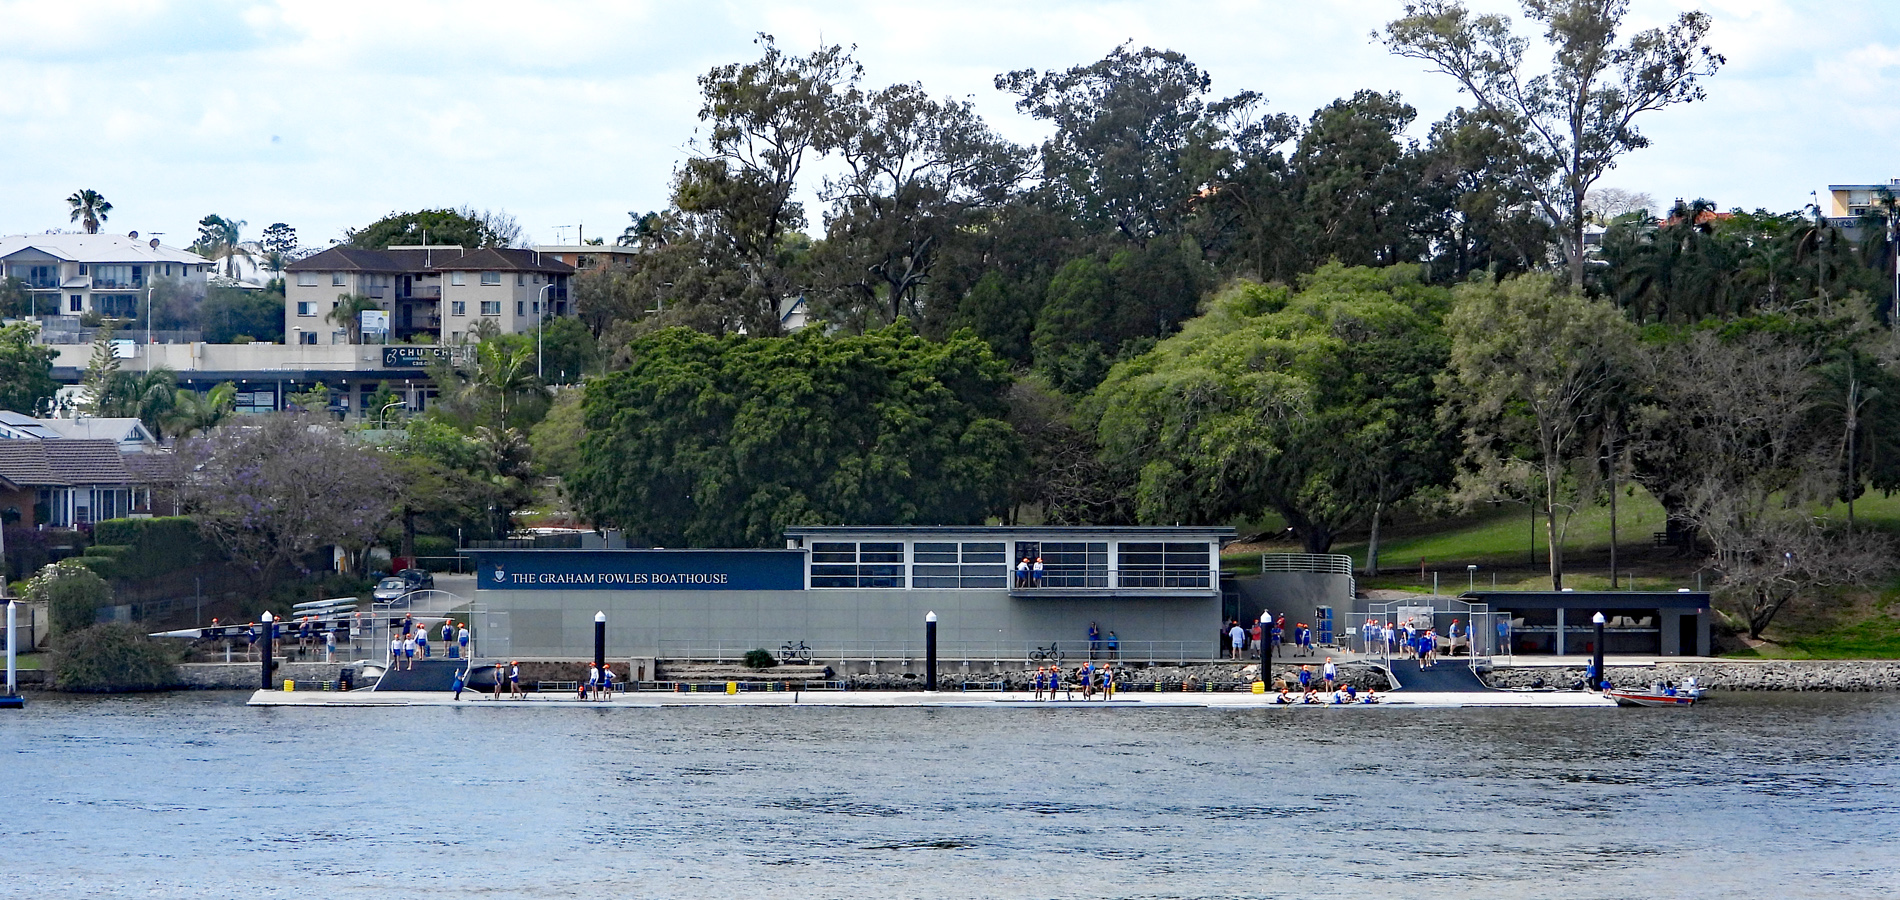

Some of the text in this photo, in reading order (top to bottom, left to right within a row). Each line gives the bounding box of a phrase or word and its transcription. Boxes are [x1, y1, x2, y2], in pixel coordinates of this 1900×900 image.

[399, 348, 448, 356] CHUCH
[511, 573, 728, 584] THE GRAHAM FOWLES BOATHOUSE
